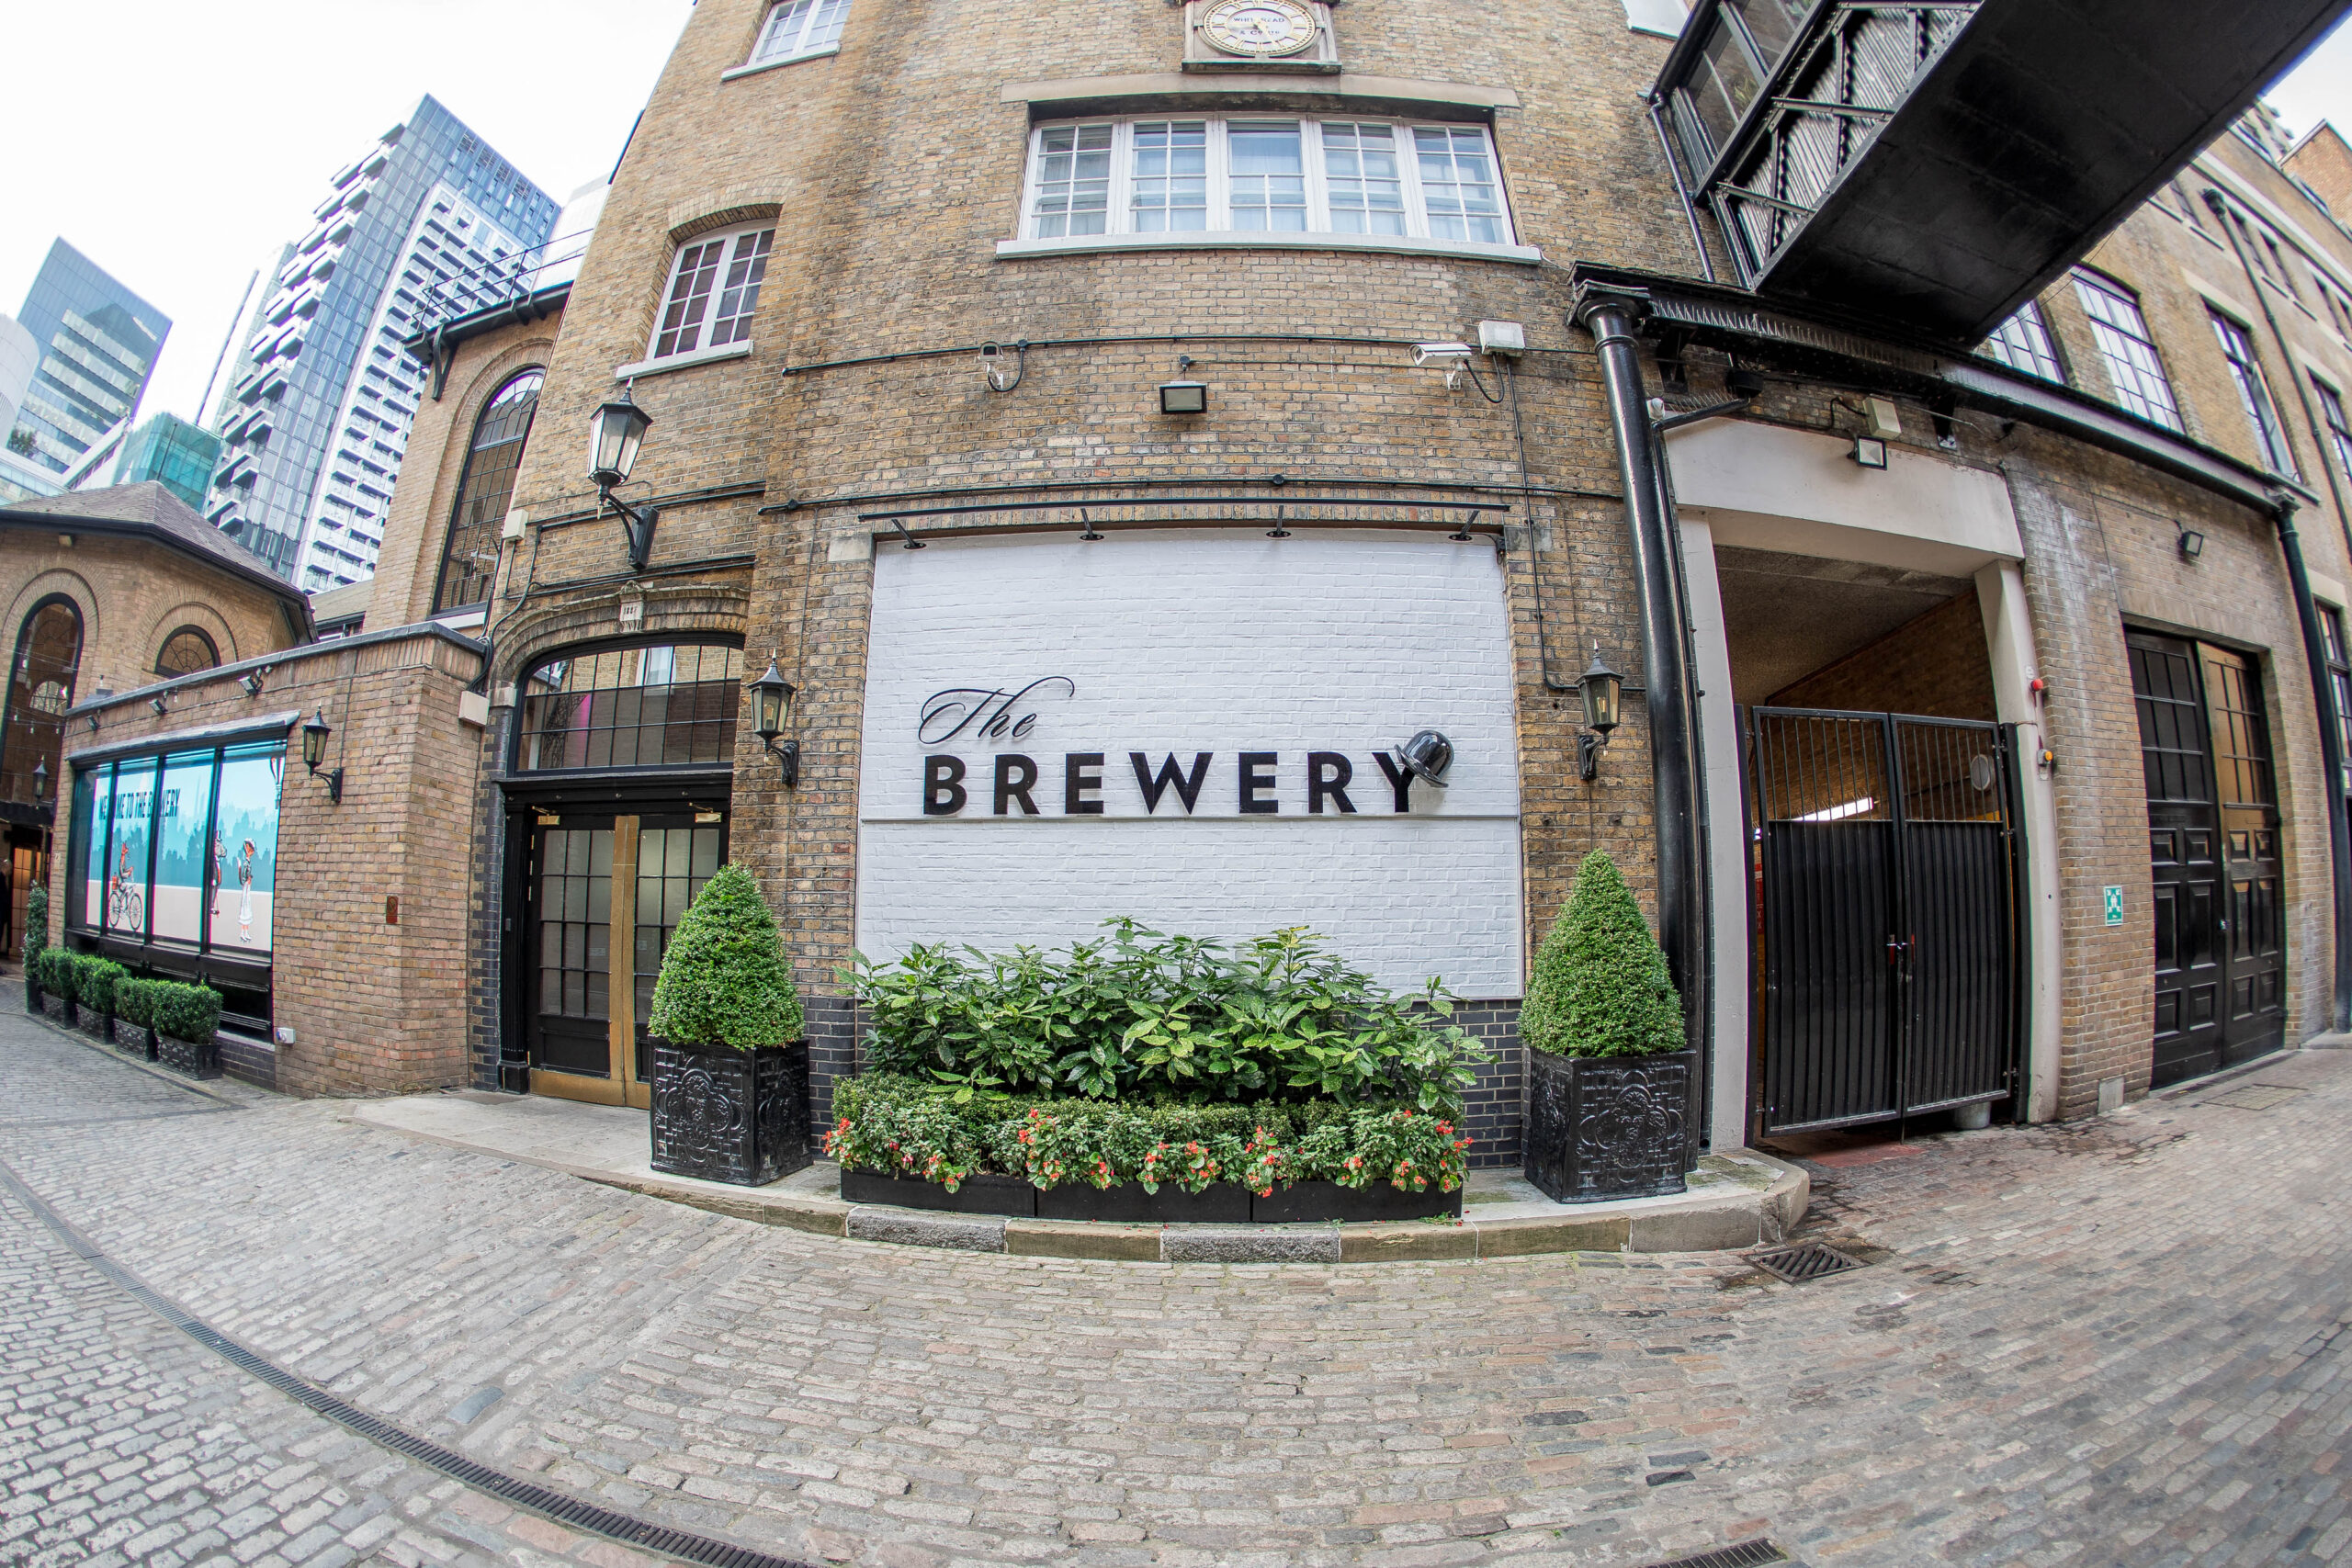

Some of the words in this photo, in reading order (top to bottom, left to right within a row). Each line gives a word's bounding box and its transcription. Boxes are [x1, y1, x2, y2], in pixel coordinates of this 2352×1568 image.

[919, 676, 1075, 744] The
[98, 794, 126, 819] WEME
[146, 788, 181, 818] BWERY
[923, 751, 1417, 815] BREWERY
